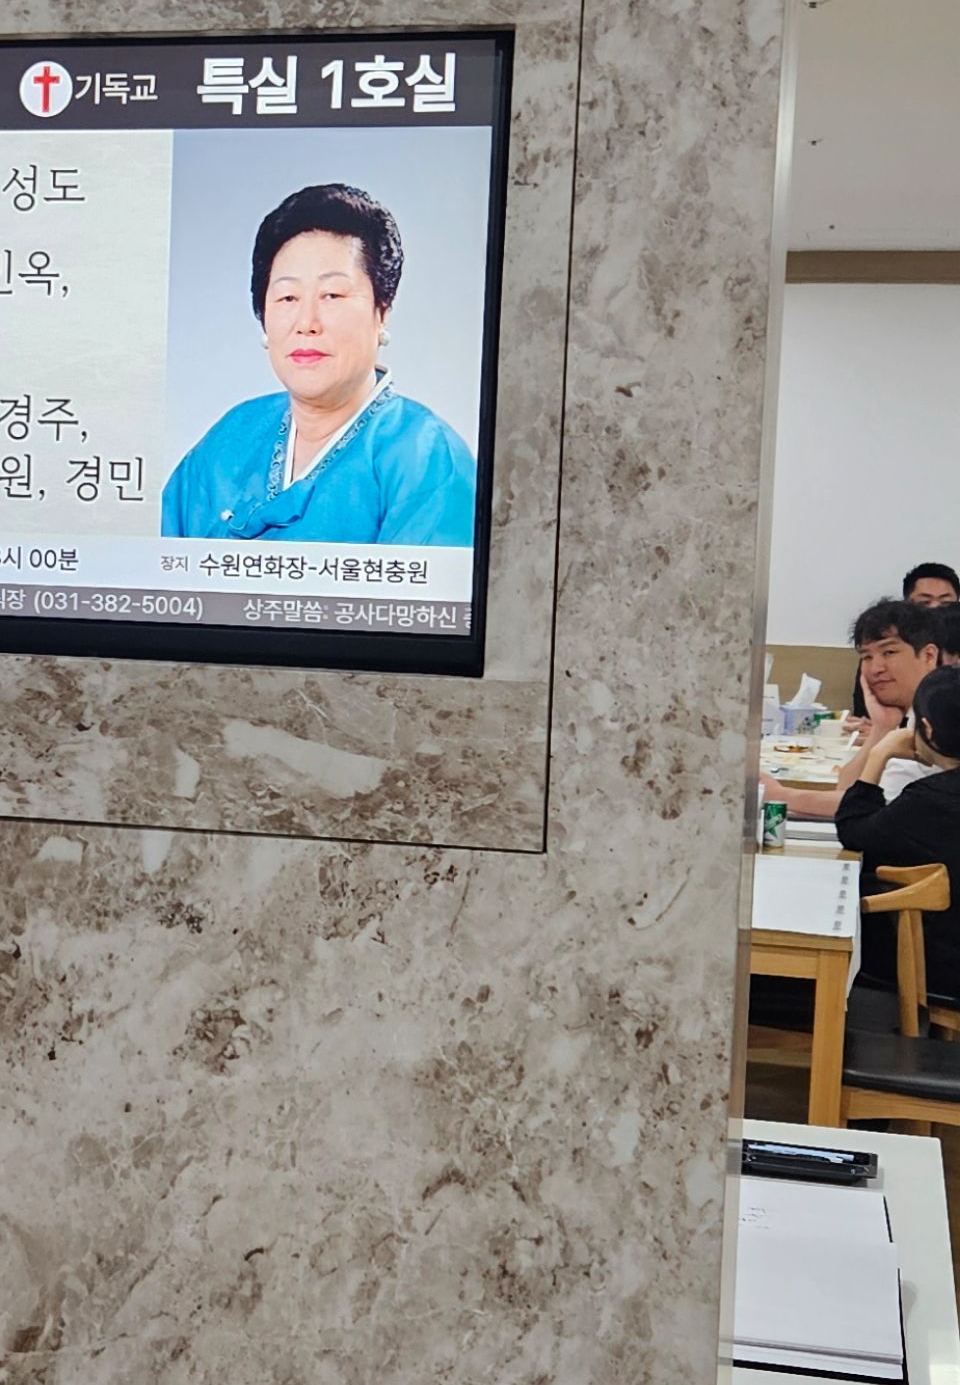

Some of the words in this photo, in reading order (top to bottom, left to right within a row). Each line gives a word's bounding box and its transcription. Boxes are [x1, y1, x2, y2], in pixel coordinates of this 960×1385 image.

[75, 72, 159, 105] 기독교
[196, 55, 298, 115] 특실
[321, 52, 456, 113] 1호실
[2, 164, 86, 212] 성도
[66, 455, 144, 502] 경민
[29, 548, 79, 571] 00분
[160, 555, 189, 572] 장지
[199, 553, 428, 585] 수원연화장-서울현충원
[33, 590, 204, 620] (031-382-5004)
[243, 598, 329, 623] 상주말씀:
[334, 601, 457, 629] 공사다망하신
